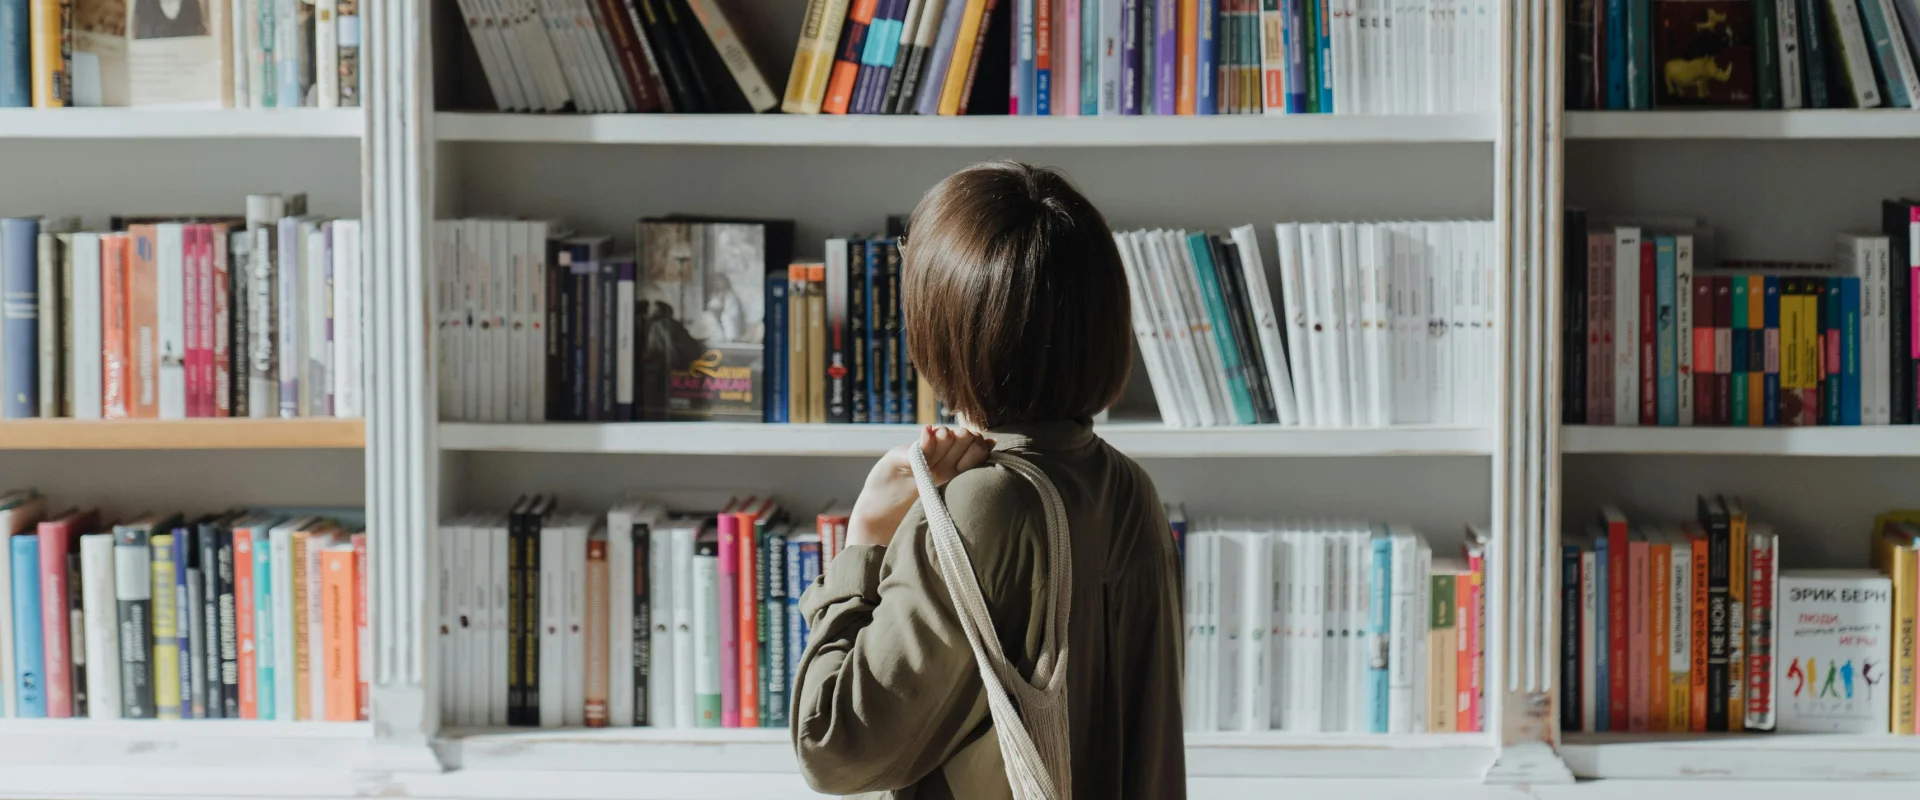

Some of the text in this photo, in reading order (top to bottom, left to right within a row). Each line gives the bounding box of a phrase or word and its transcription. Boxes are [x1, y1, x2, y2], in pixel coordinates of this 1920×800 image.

[1790, 587, 1886, 603] ЭРИК БЕРН
[1693, 553, 1706, 687] ЦИФРОВОЙ ЭТИКЕТ
[1710, 596, 1725, 632] НОЙ
[1798, 613, 1839, 625] ЛЮДИ
[1711, 634, 1725, 655] НЕ
